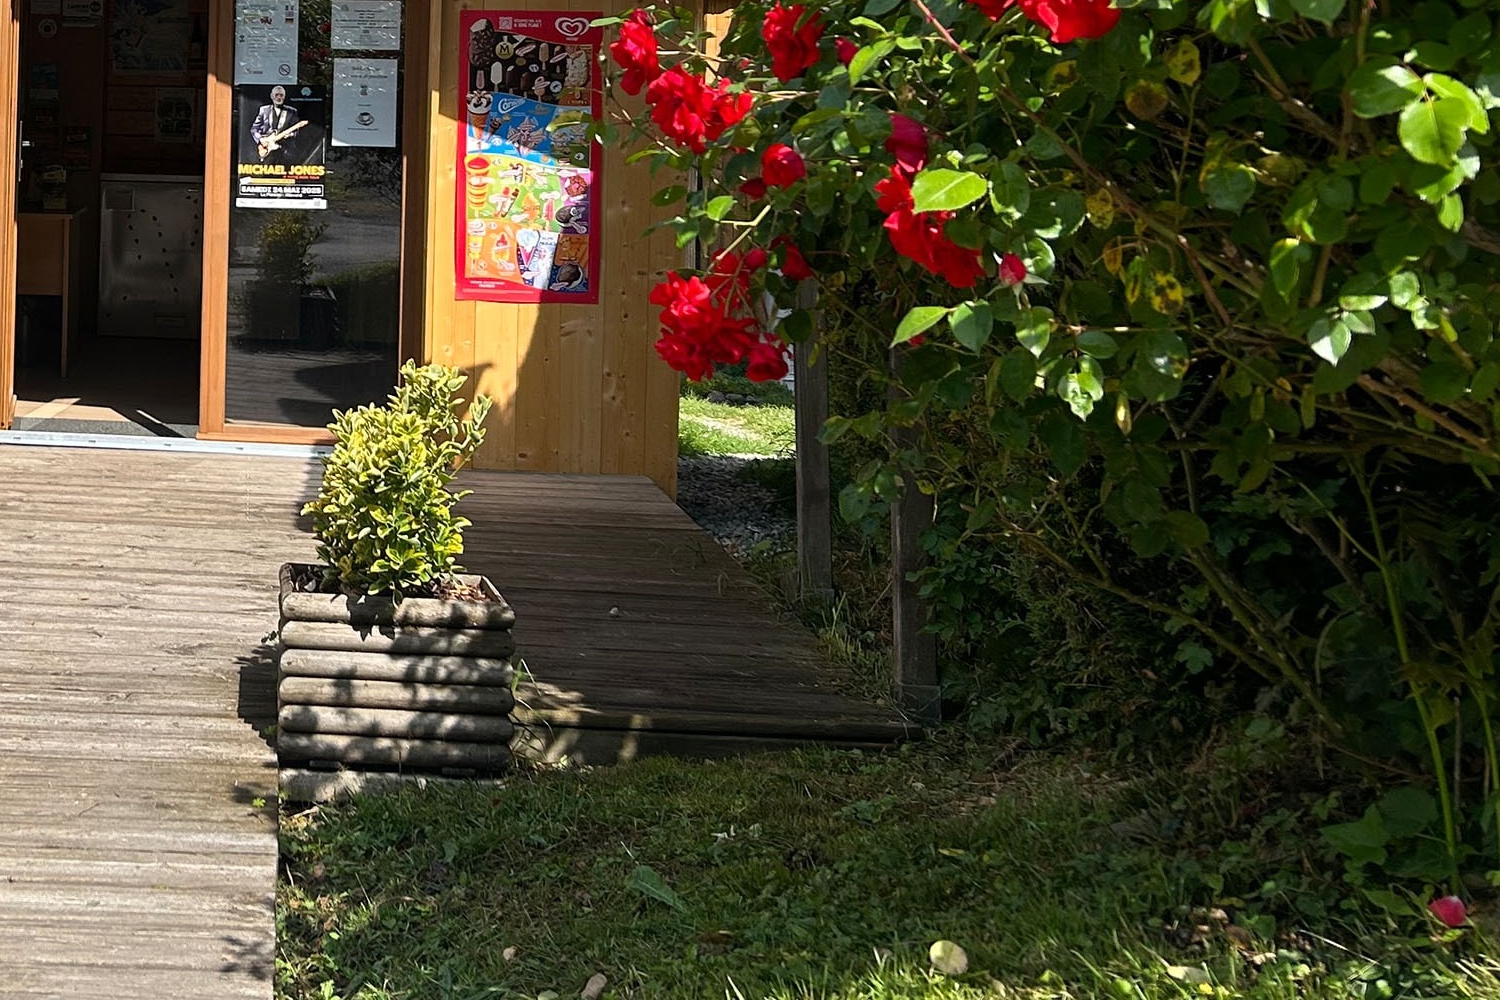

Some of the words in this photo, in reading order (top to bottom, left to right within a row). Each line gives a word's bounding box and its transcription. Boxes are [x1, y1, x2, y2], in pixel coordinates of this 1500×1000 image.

[238, 164, 287, 175] MICHAEL
[288, 165, 325, 176] JONES
[284, 186, 300, 194] MAI
